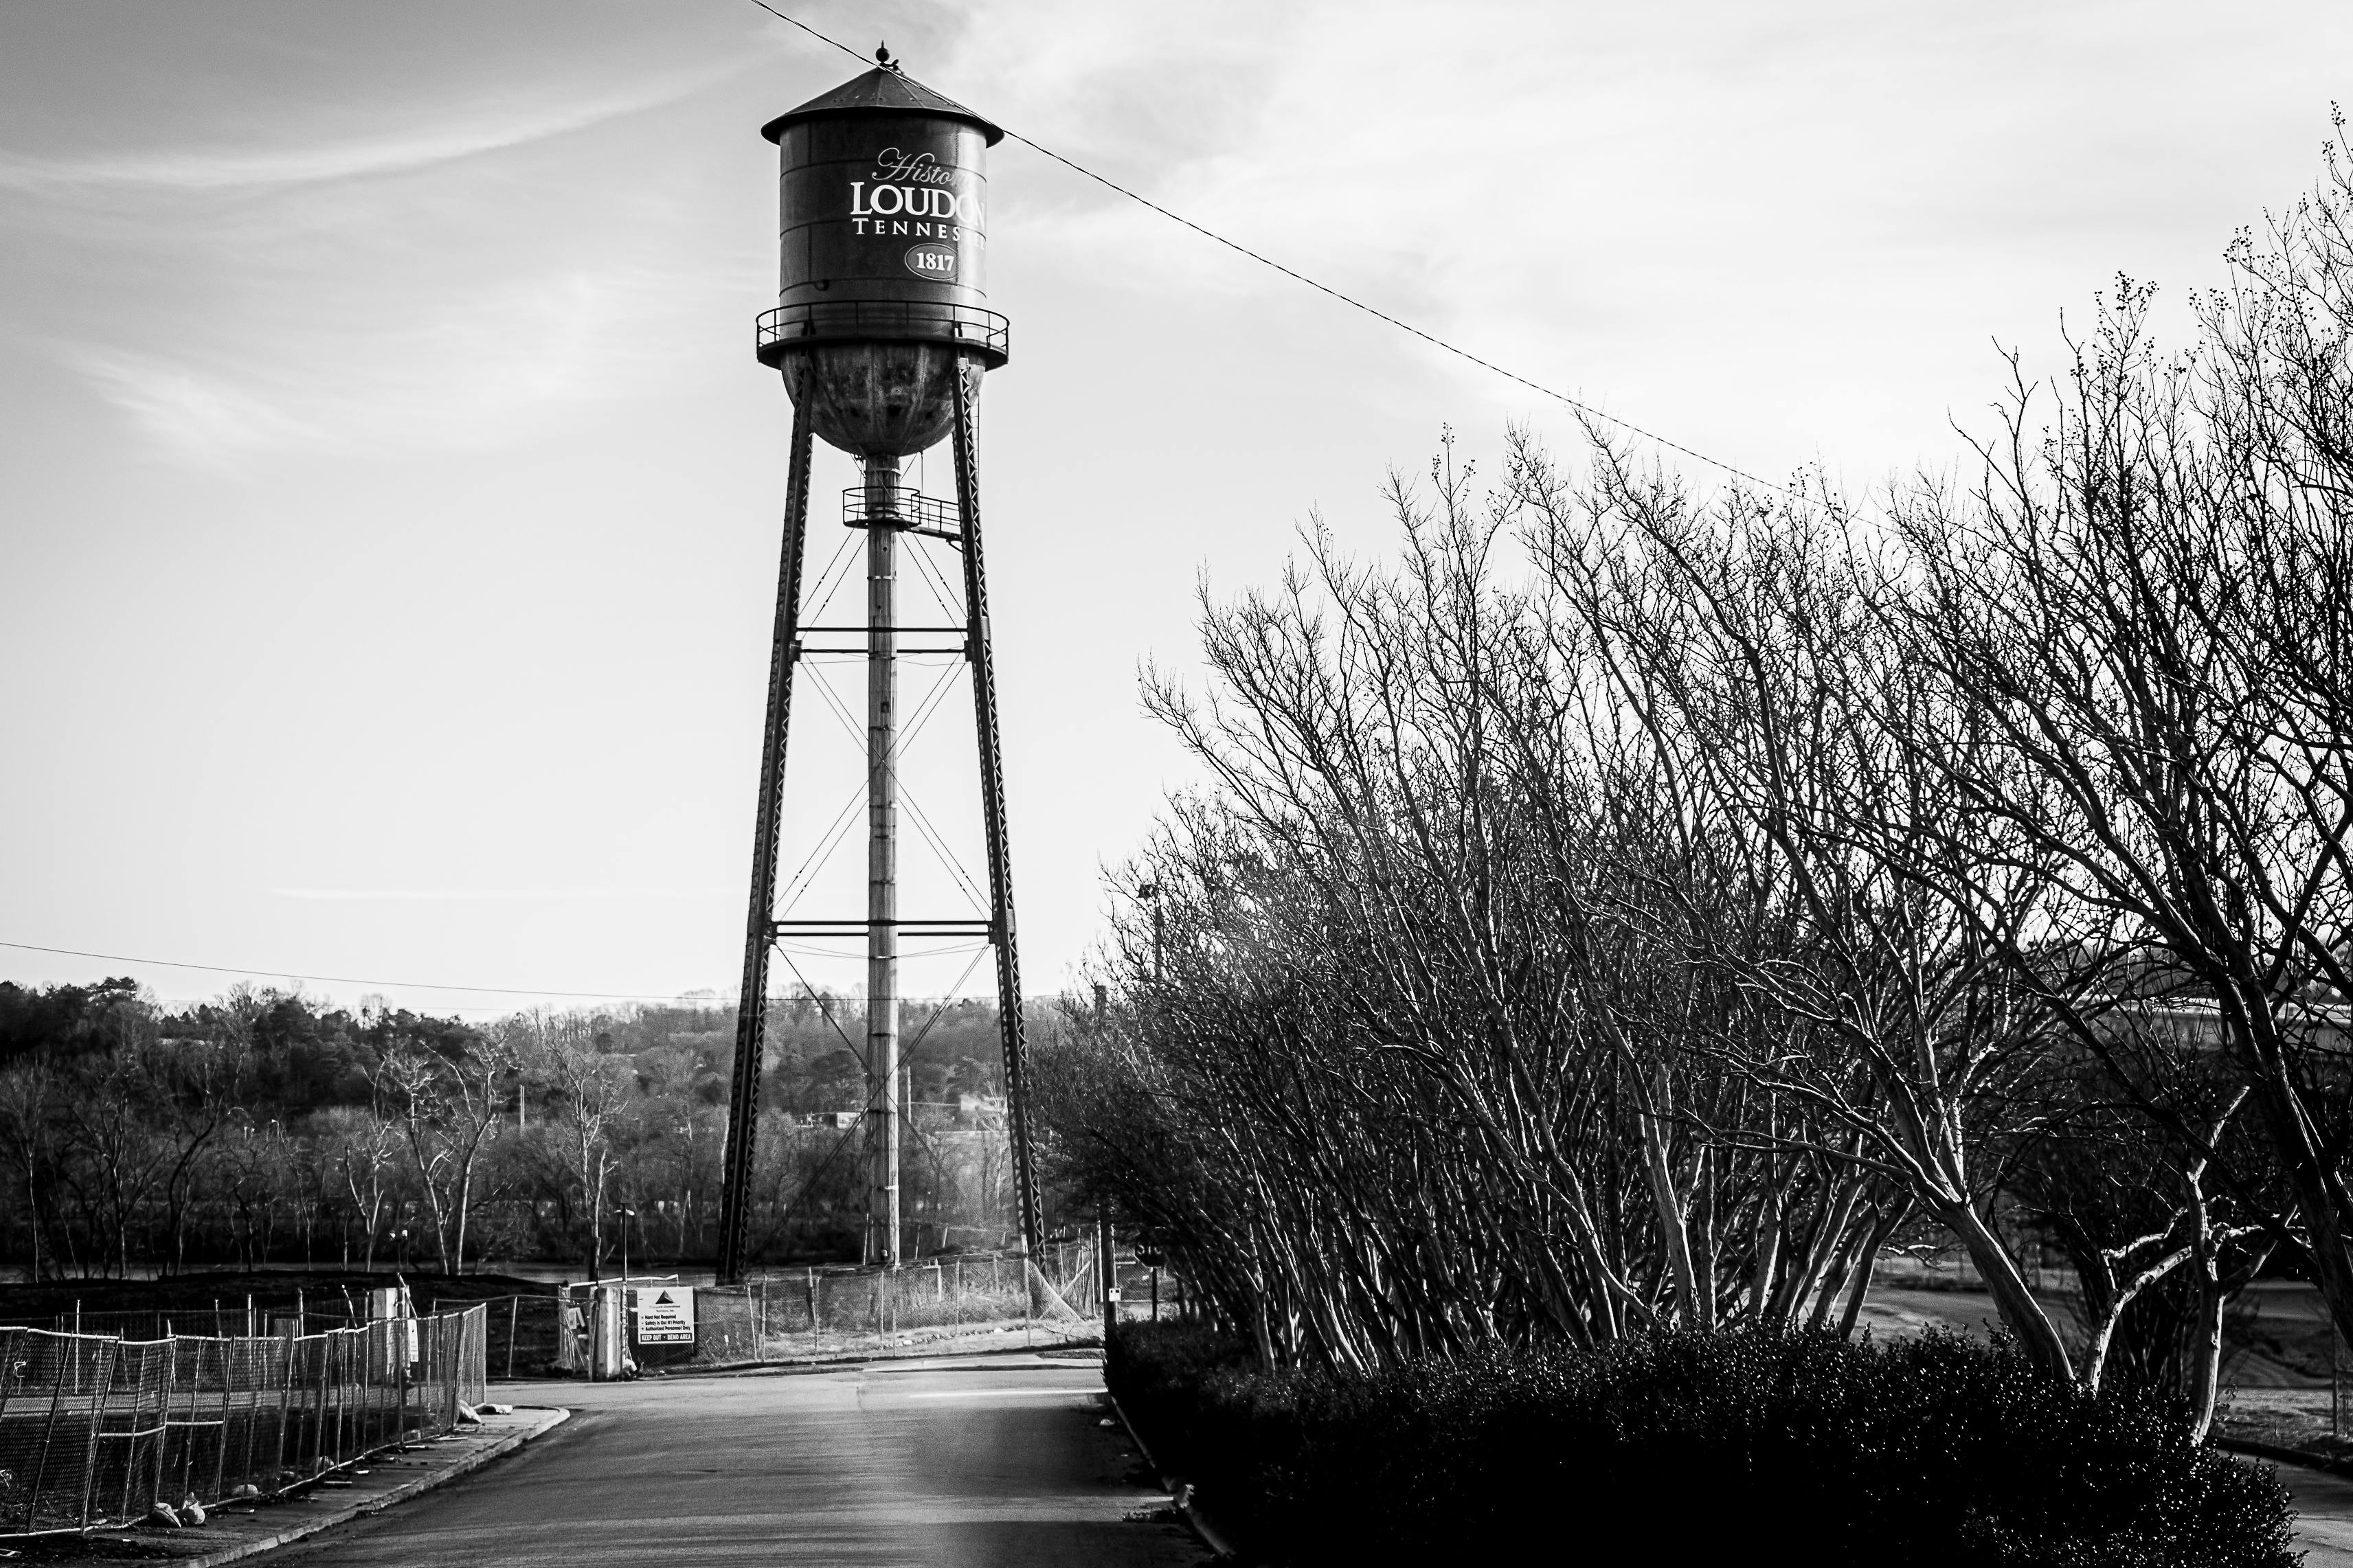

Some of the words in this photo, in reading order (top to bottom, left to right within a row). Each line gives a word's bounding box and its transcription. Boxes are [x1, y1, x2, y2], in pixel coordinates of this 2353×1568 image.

[872, 147, 965, 188] Histor
[850, 181, 984, 230] LOUDON
[916, 252, 955, 271] 1817
